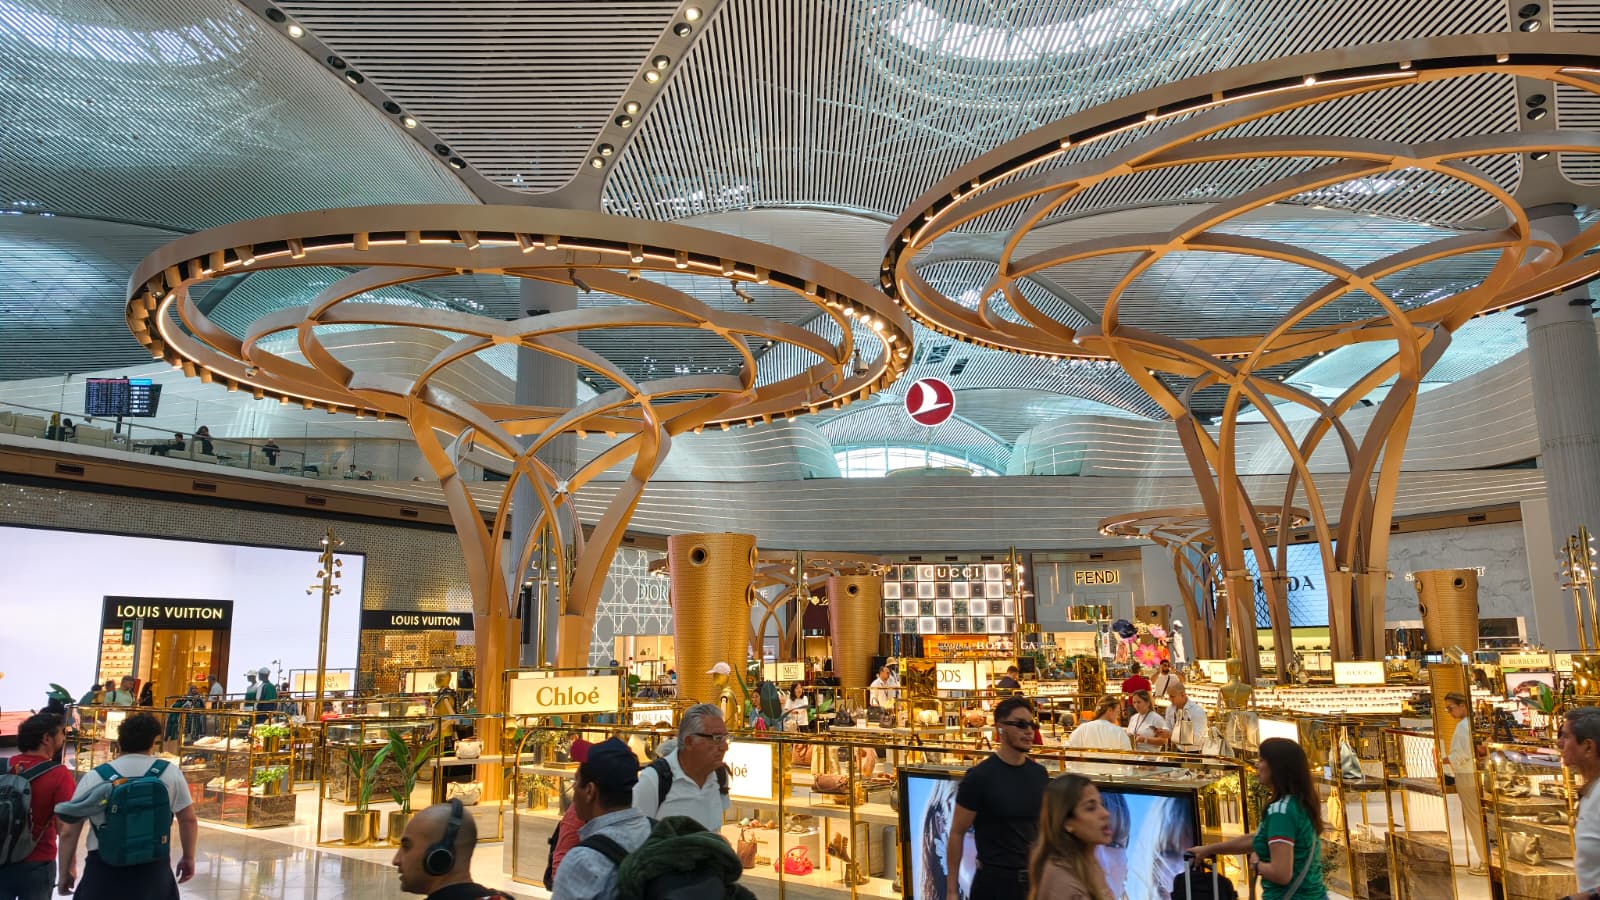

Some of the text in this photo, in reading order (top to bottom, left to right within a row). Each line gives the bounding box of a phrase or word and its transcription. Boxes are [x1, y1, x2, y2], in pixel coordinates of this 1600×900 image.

[1075, 570, 1119, 584] FENDI
[117, 605, 223, 619] LOUIS VUITTON
[391, 615, 460, 626] LOUIS VUITTON
[937, 670, 961, 682] OD'S
[536, 686, 600, 707] Chloé
